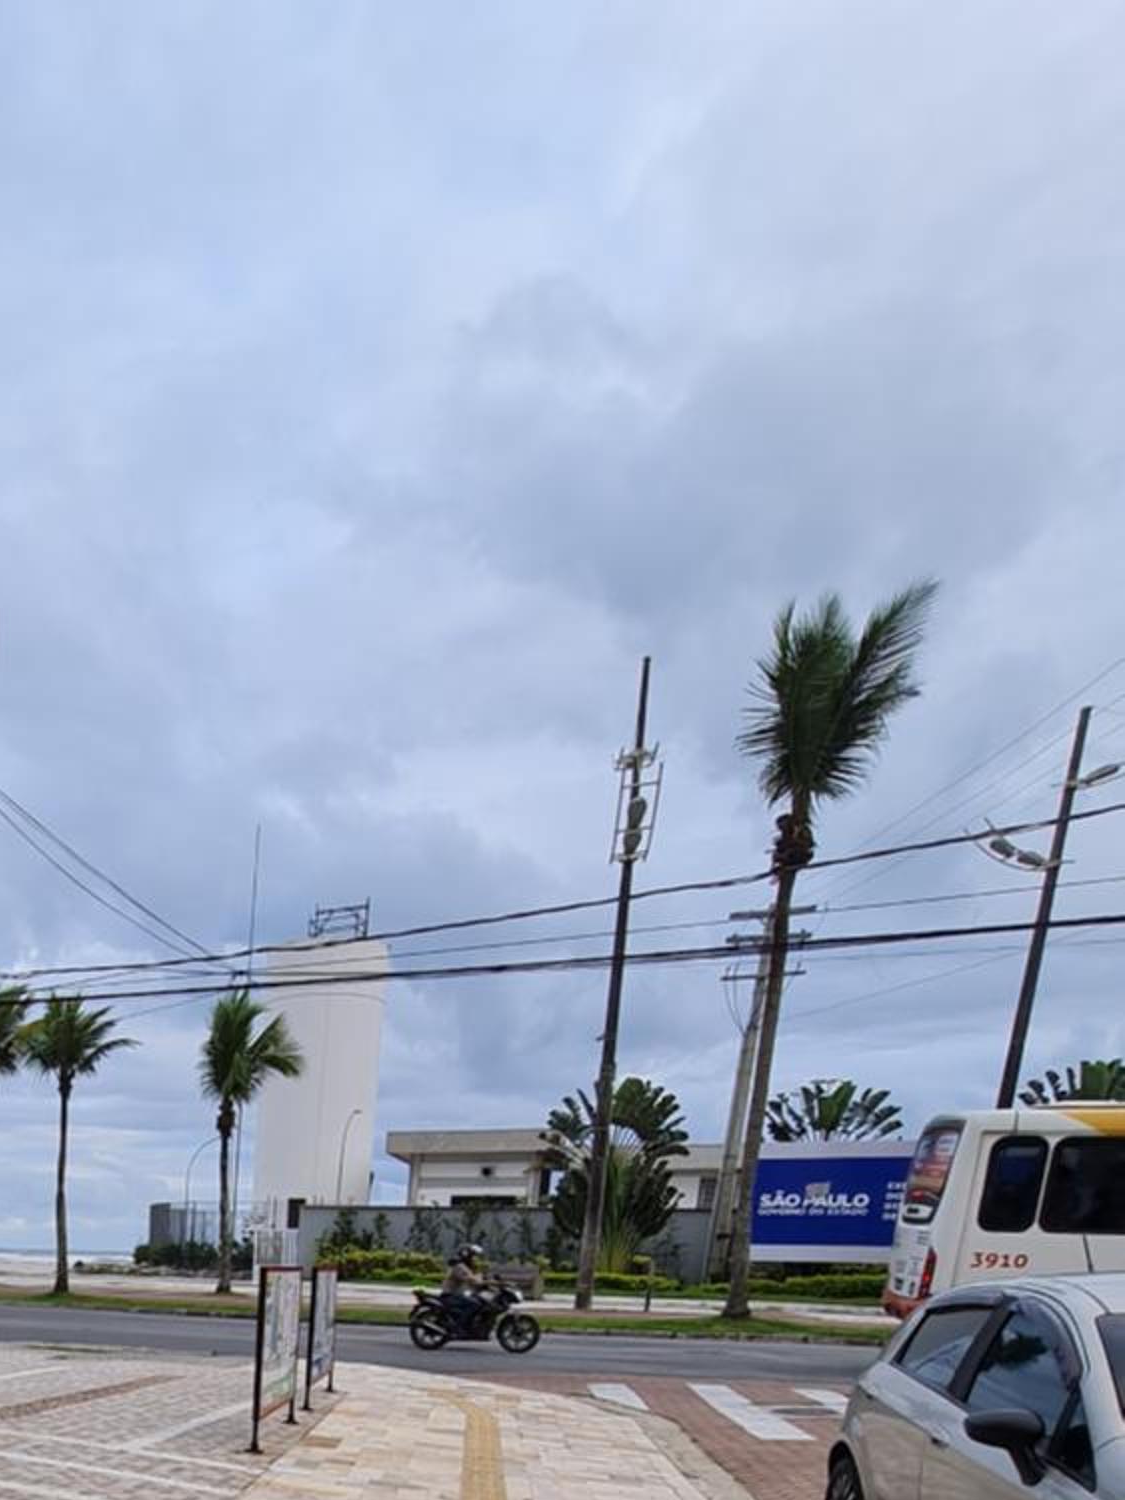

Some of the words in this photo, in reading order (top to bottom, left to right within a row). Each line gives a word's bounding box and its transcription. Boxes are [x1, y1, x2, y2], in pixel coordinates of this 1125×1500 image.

[759, 1189, 801, 1208] SÃO
[802, 1192, 871, 1208] PAULO
[970, 1251, 1030, 1270] 3910
